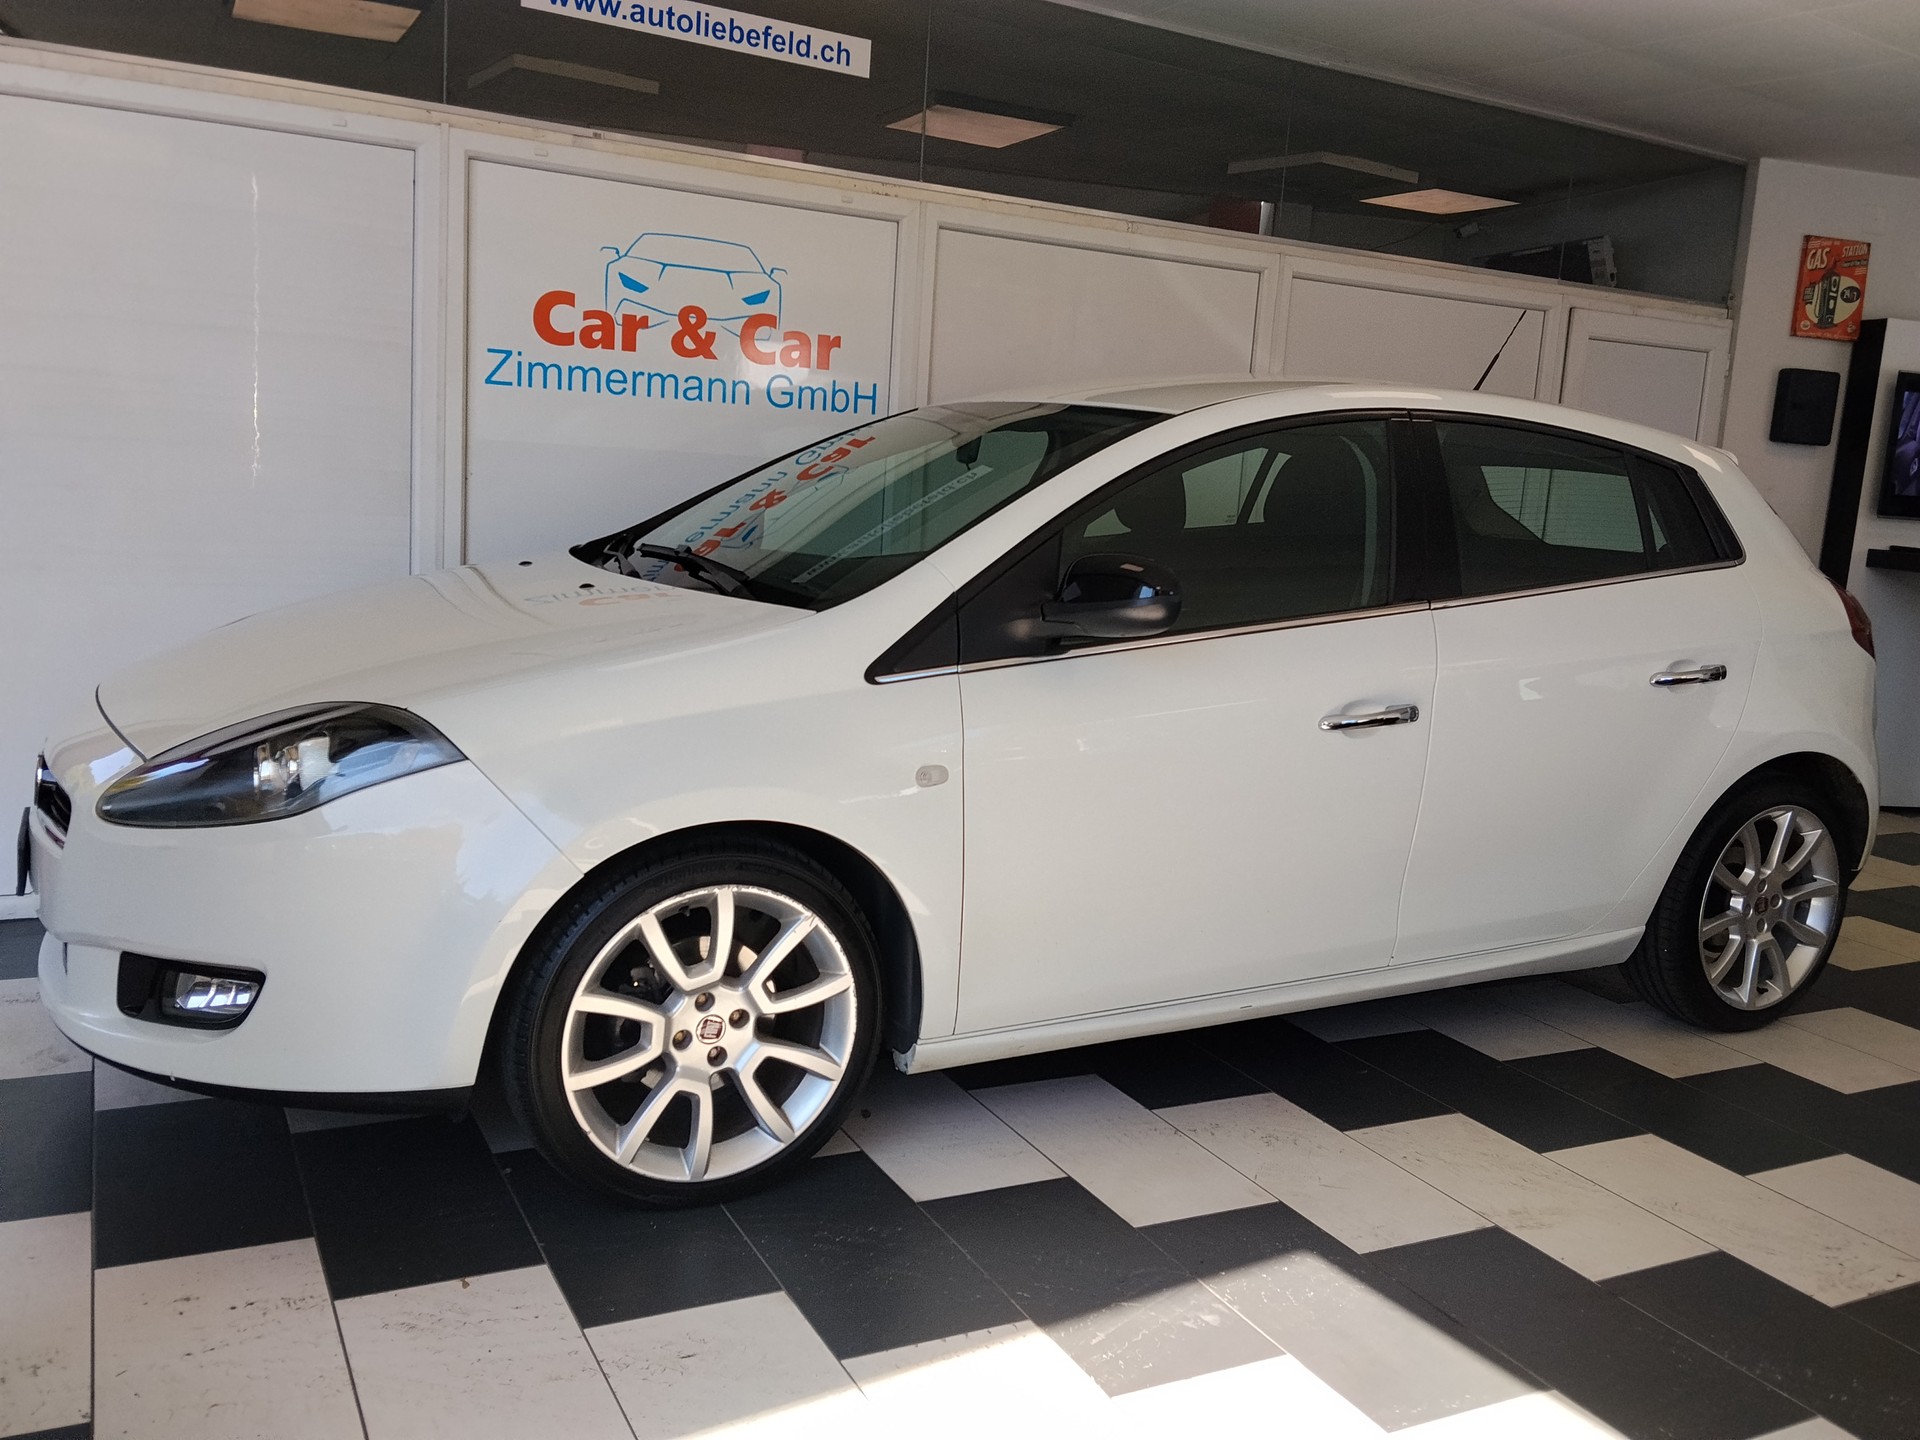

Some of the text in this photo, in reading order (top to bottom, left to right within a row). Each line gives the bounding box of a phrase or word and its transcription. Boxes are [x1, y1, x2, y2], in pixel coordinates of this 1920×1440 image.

[1807, 247, 1831, 270] GAS
[533, 290, 841, 371] Car & Car
[484, 348, 878, 416] Zimmermann GmbH
